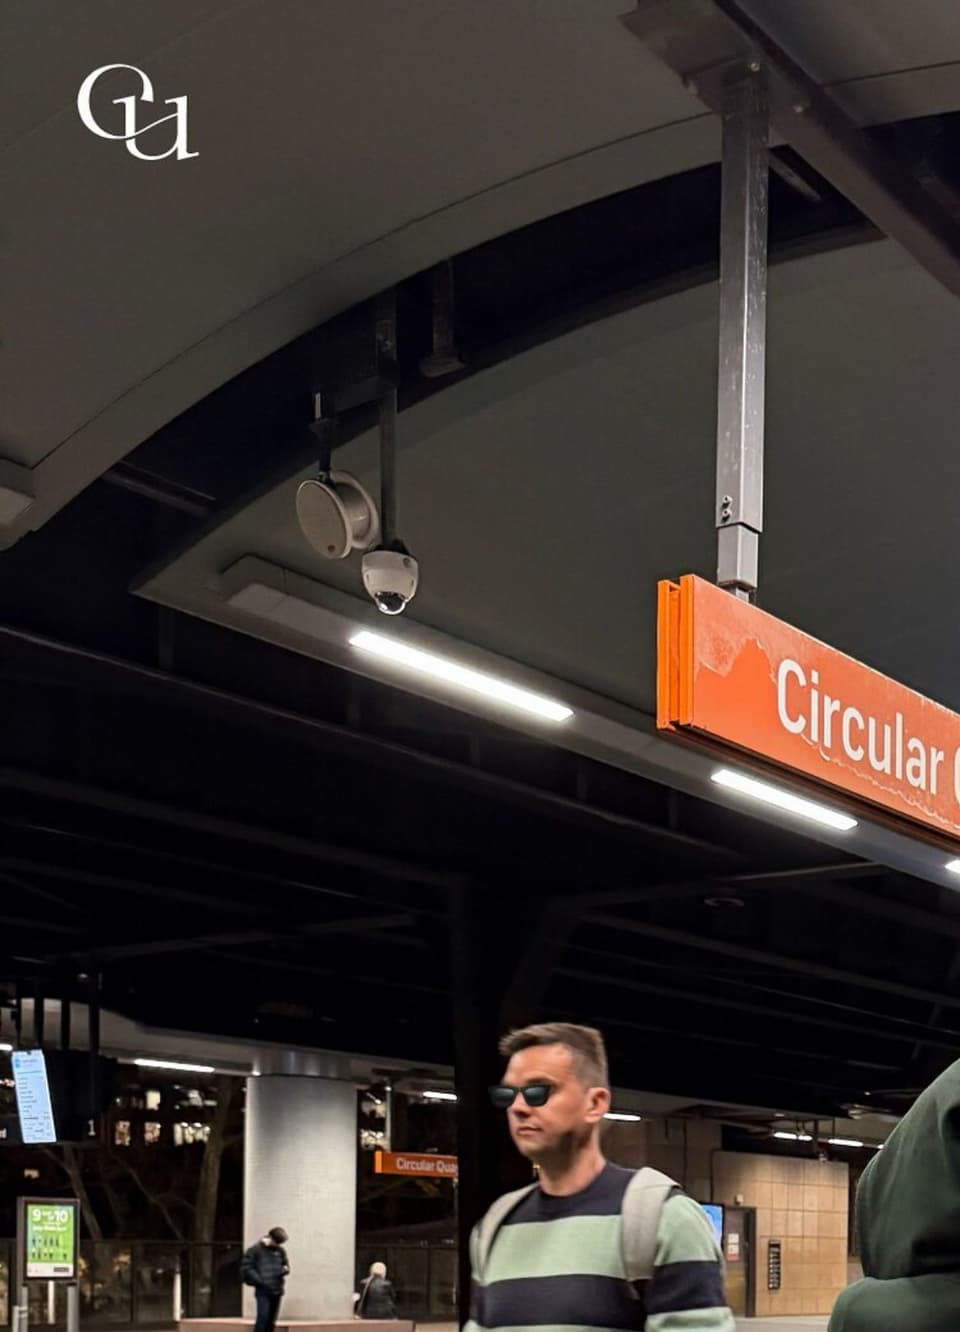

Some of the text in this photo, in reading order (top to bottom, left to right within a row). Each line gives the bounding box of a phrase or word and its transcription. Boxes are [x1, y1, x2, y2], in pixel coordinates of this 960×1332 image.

[776, 658, 945, 796] Circular
[88, 1119, 96, 1136] 1
[396, 1157, 458, 1176] Circular Qua
